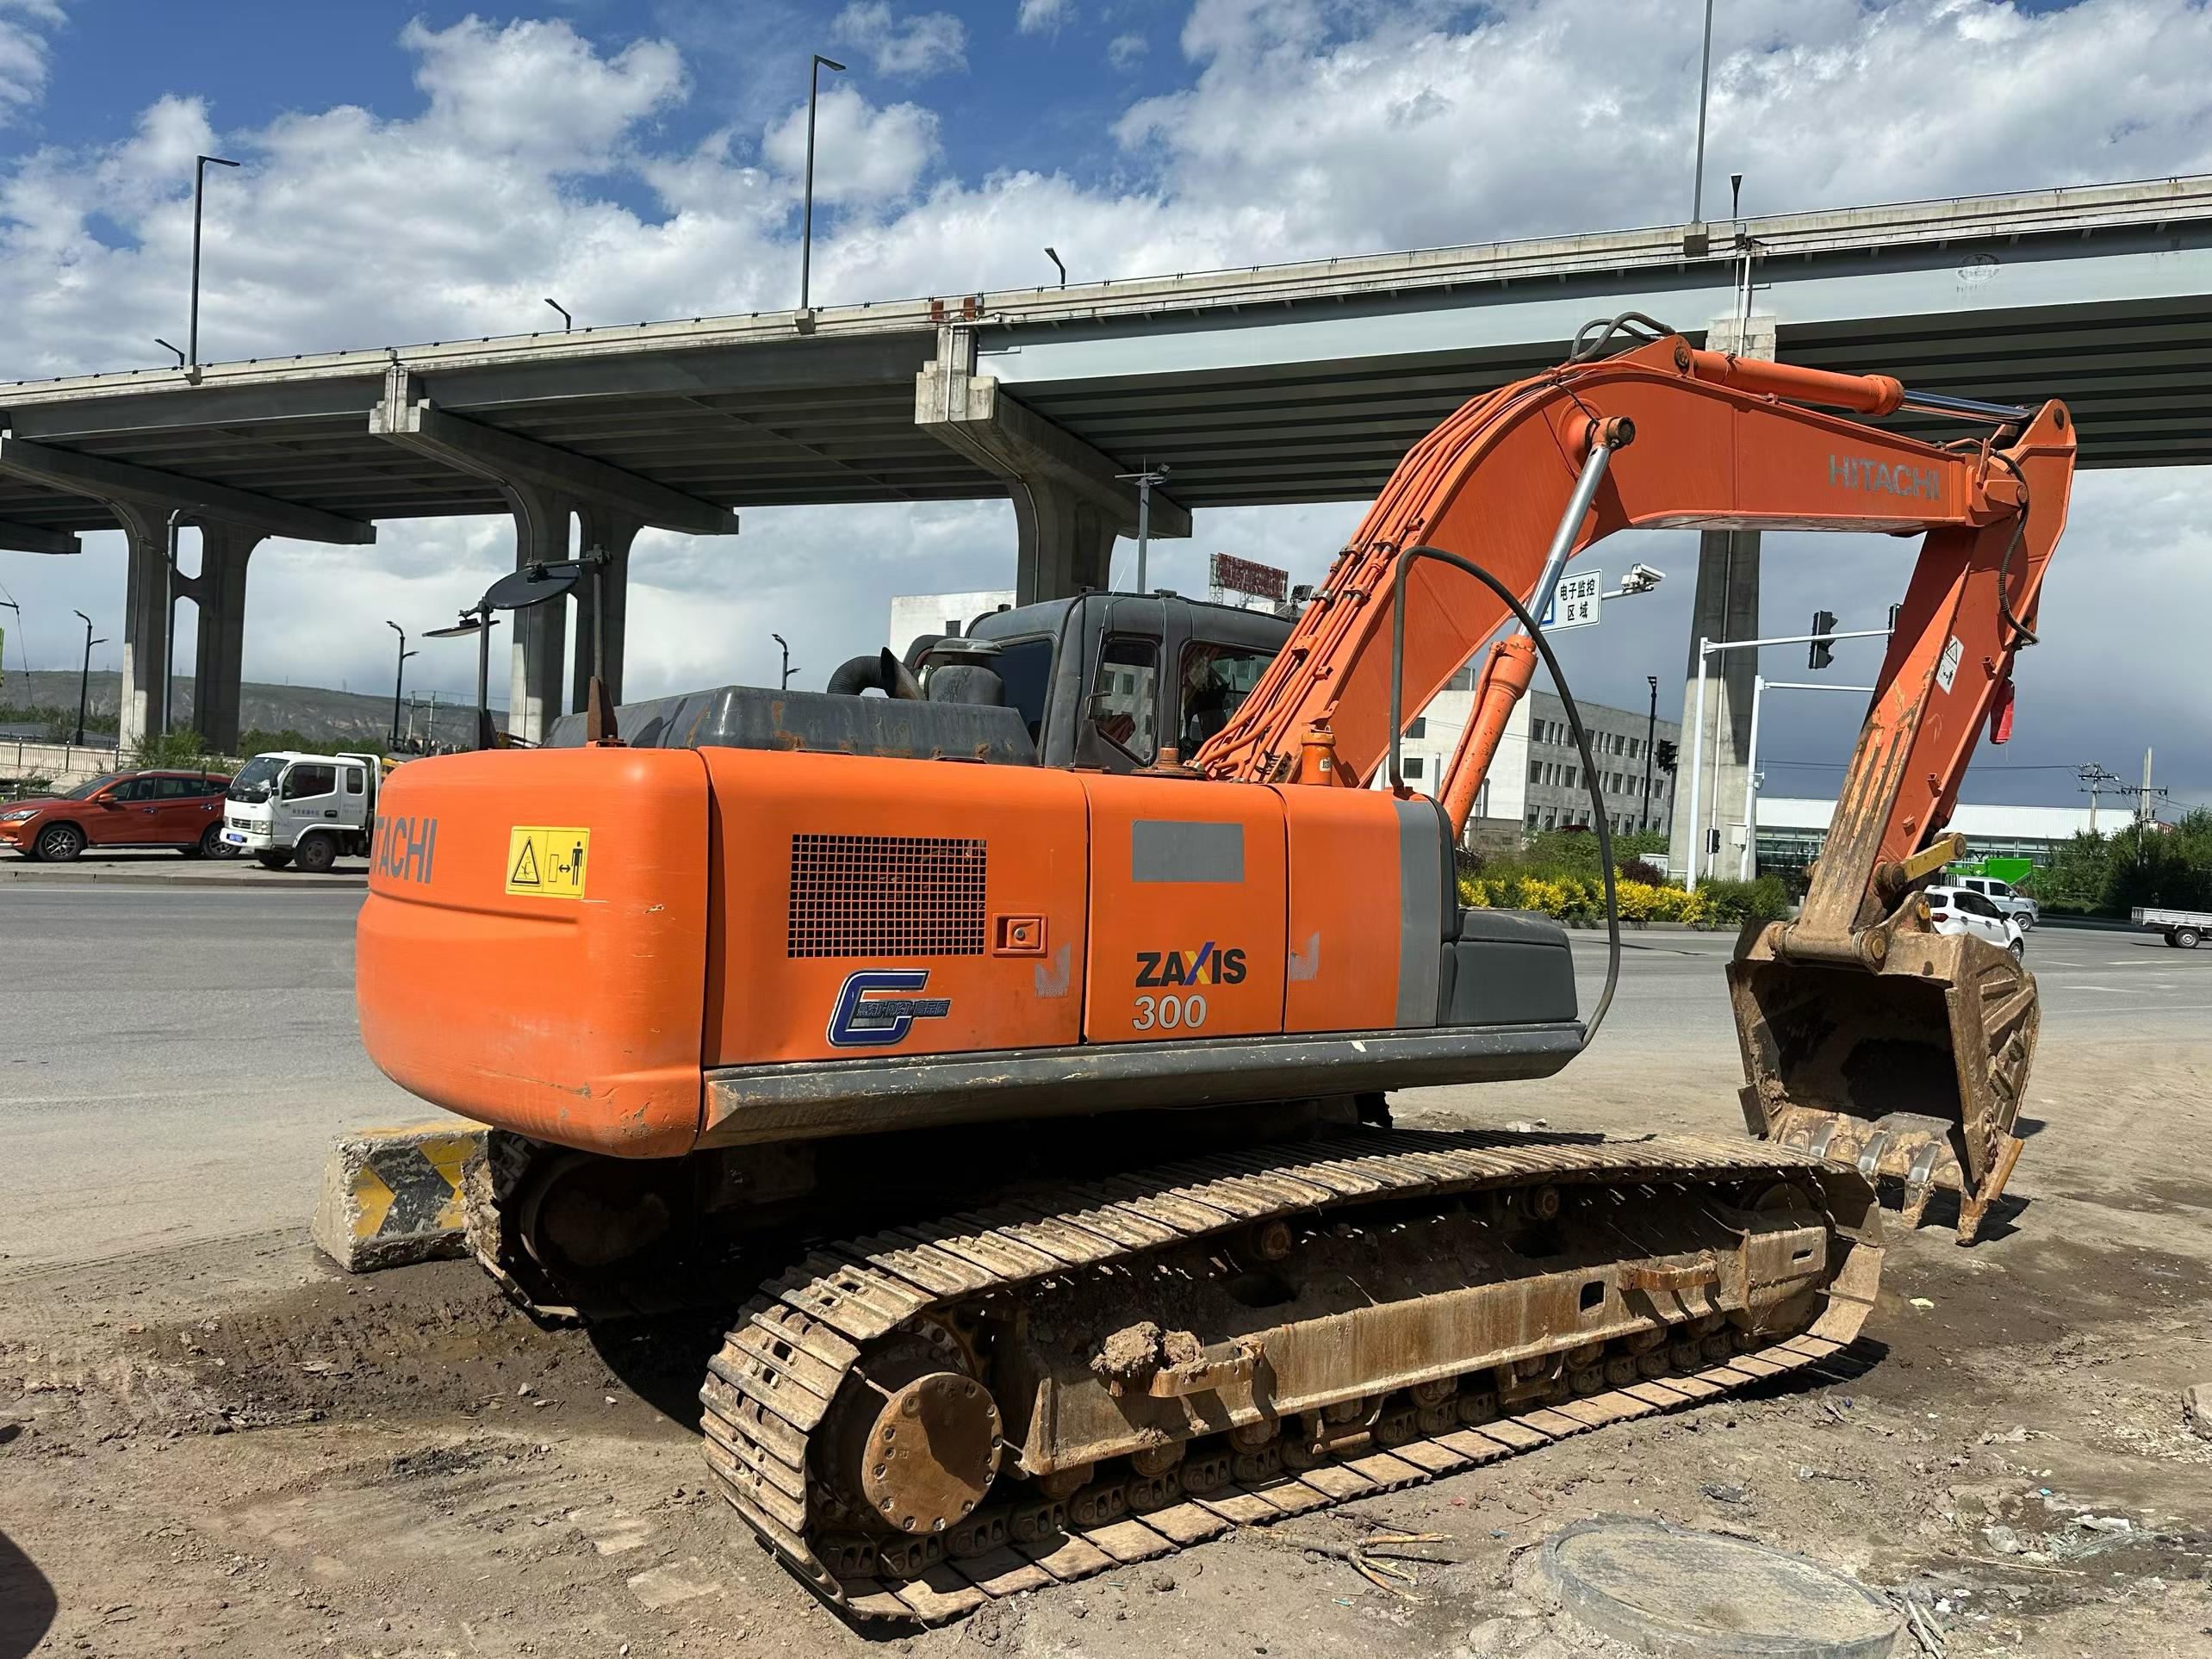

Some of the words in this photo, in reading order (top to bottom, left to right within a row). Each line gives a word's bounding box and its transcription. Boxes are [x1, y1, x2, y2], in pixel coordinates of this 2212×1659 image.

[1829, 454, 1940, 500] HITACHI
[1560, 578, 1595, 601] 电子监控
[1568, 600, 1588, 621] 区域
[374, 816, 438, 884] TACHI
[1135, 941, 1247, 987] ZAXIS
[1132, 994, 1208, 1030] 300
